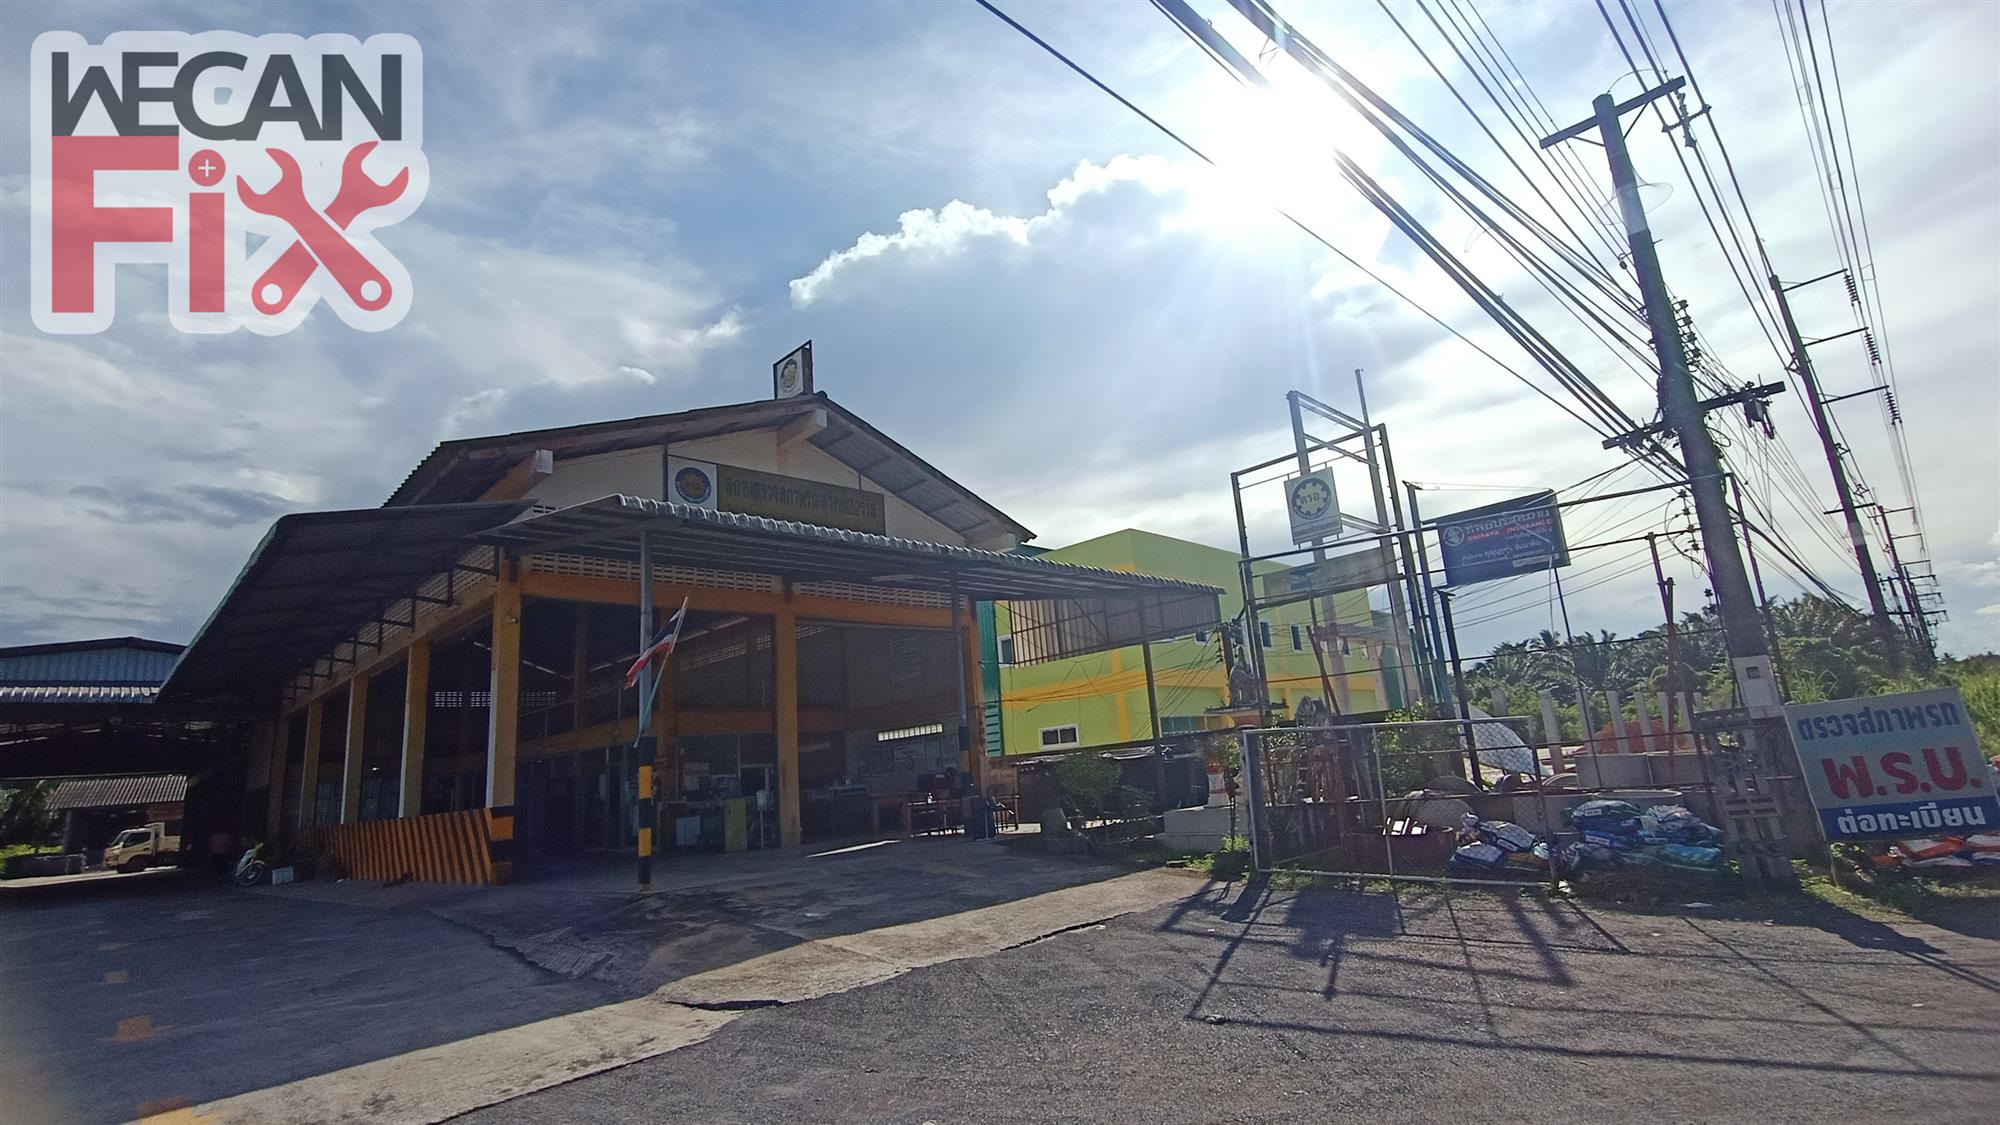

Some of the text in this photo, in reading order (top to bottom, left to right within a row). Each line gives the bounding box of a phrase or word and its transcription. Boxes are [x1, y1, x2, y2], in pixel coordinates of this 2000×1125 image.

[1797, 701, 1961, 741] ตรวจสภาพรถ
[1821, 746, 1983, 800] พ.ร.บ.
[1837, 801, 1986, 834] ต่อทะเบียน
